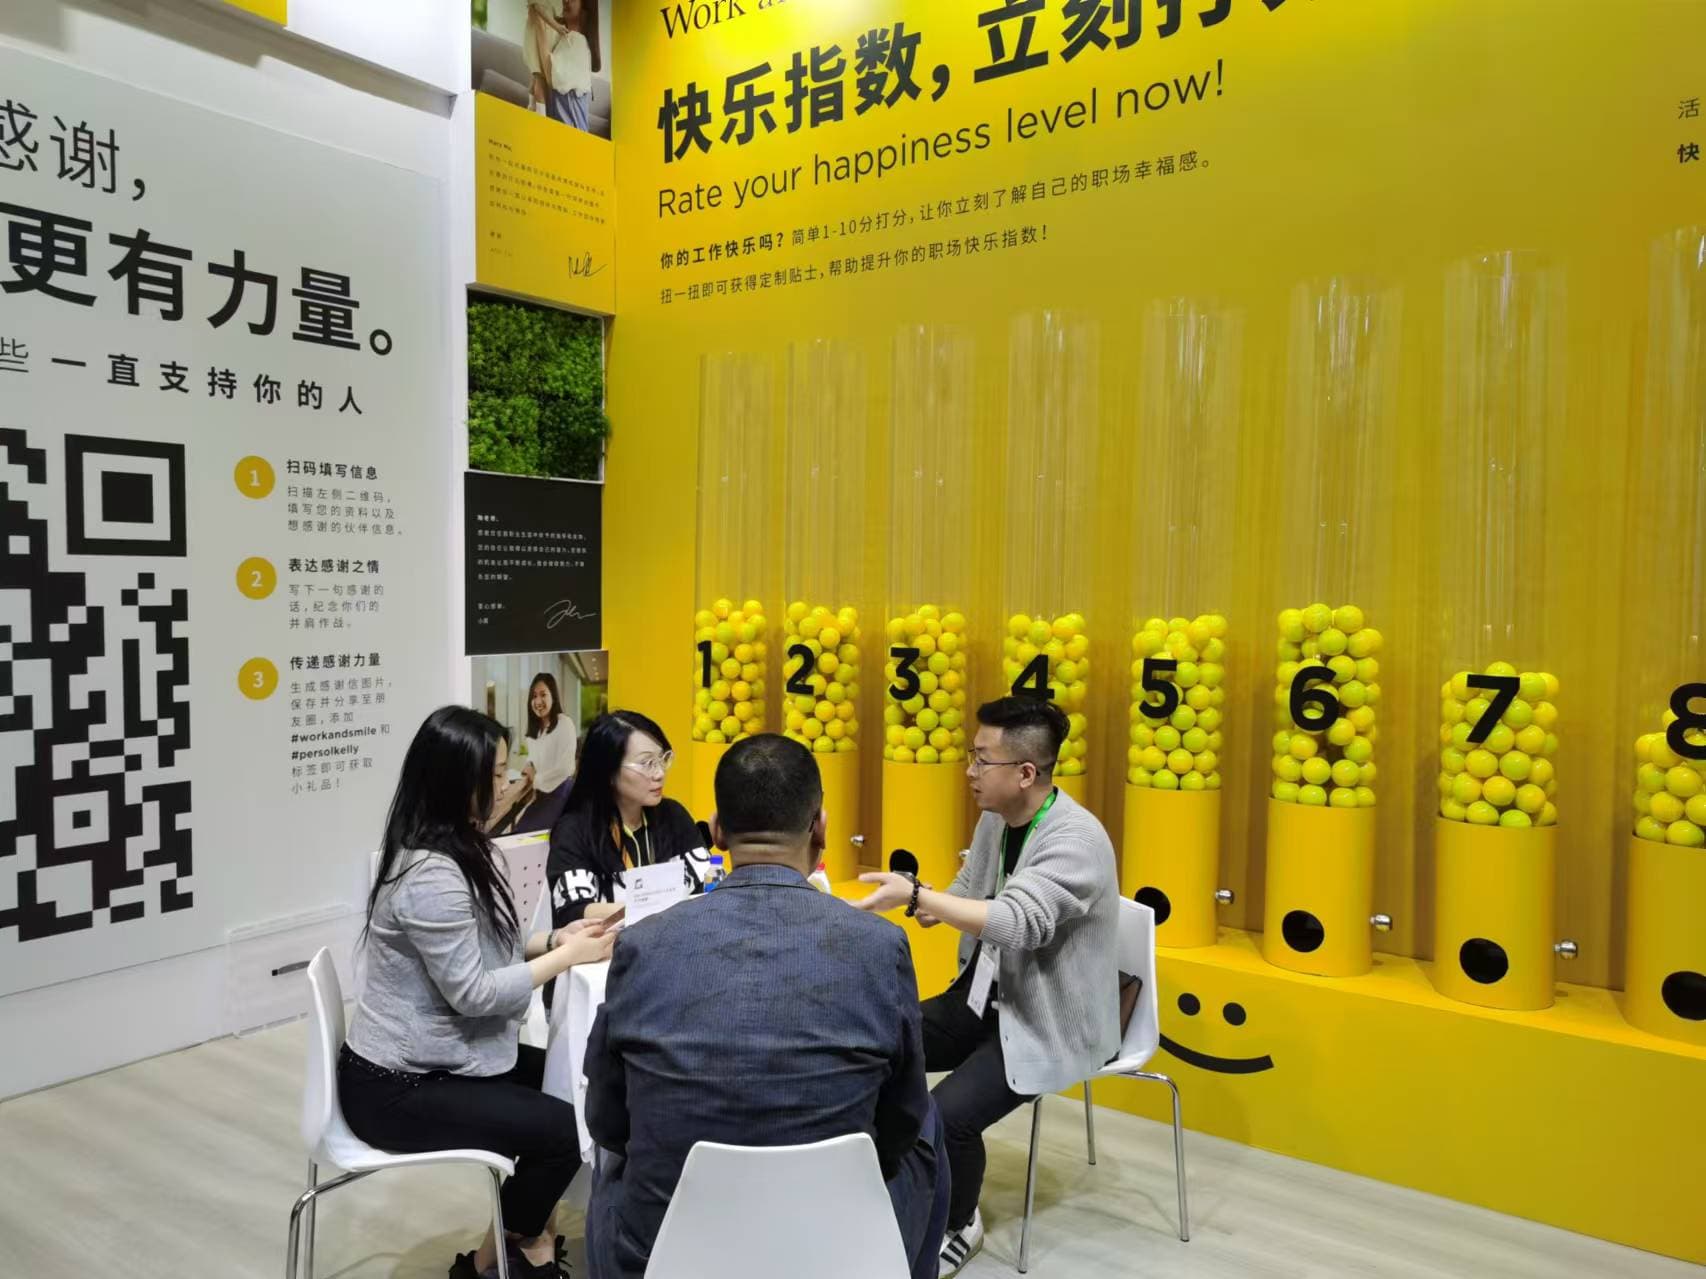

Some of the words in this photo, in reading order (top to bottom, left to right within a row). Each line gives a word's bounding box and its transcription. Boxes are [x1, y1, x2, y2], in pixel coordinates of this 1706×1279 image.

[1678, 98, 1700, 119] 活
[658, 183, 722, 218] Rate
[733, 164, 803, 209] your
[814, 121, 991, 185] happiness
[1007, 87, 1097, 143] level
[1116, 59, 1223, 118] now!
[1677, 142, 1700, 163] 快
[0, 203, 393, 356] 更有力量。
[286, 459, 379, 480] 扫码填写信息
[288, 558, 380, 574] 表达感谢之情
[288, 584, 384, 596] 写下一句感谢的
[290, 652, 381, 670] 传递感谢力量
[697, 640, 712, 688] 1
[786, 644, 815, 695] 2
[889, 647, 920, 700] 3
[1011, 654, 1055, 700] 4
[1139, 658, 1178, 719] 5
[1290, 666, 1339, 732] 6
[1466, 673, 1521, 744] 7
[291, 726, 377, 743] #workandsmile
[1666, 683, 1706, 761] 8
[291, 744, 359, 761] #persolkelly
